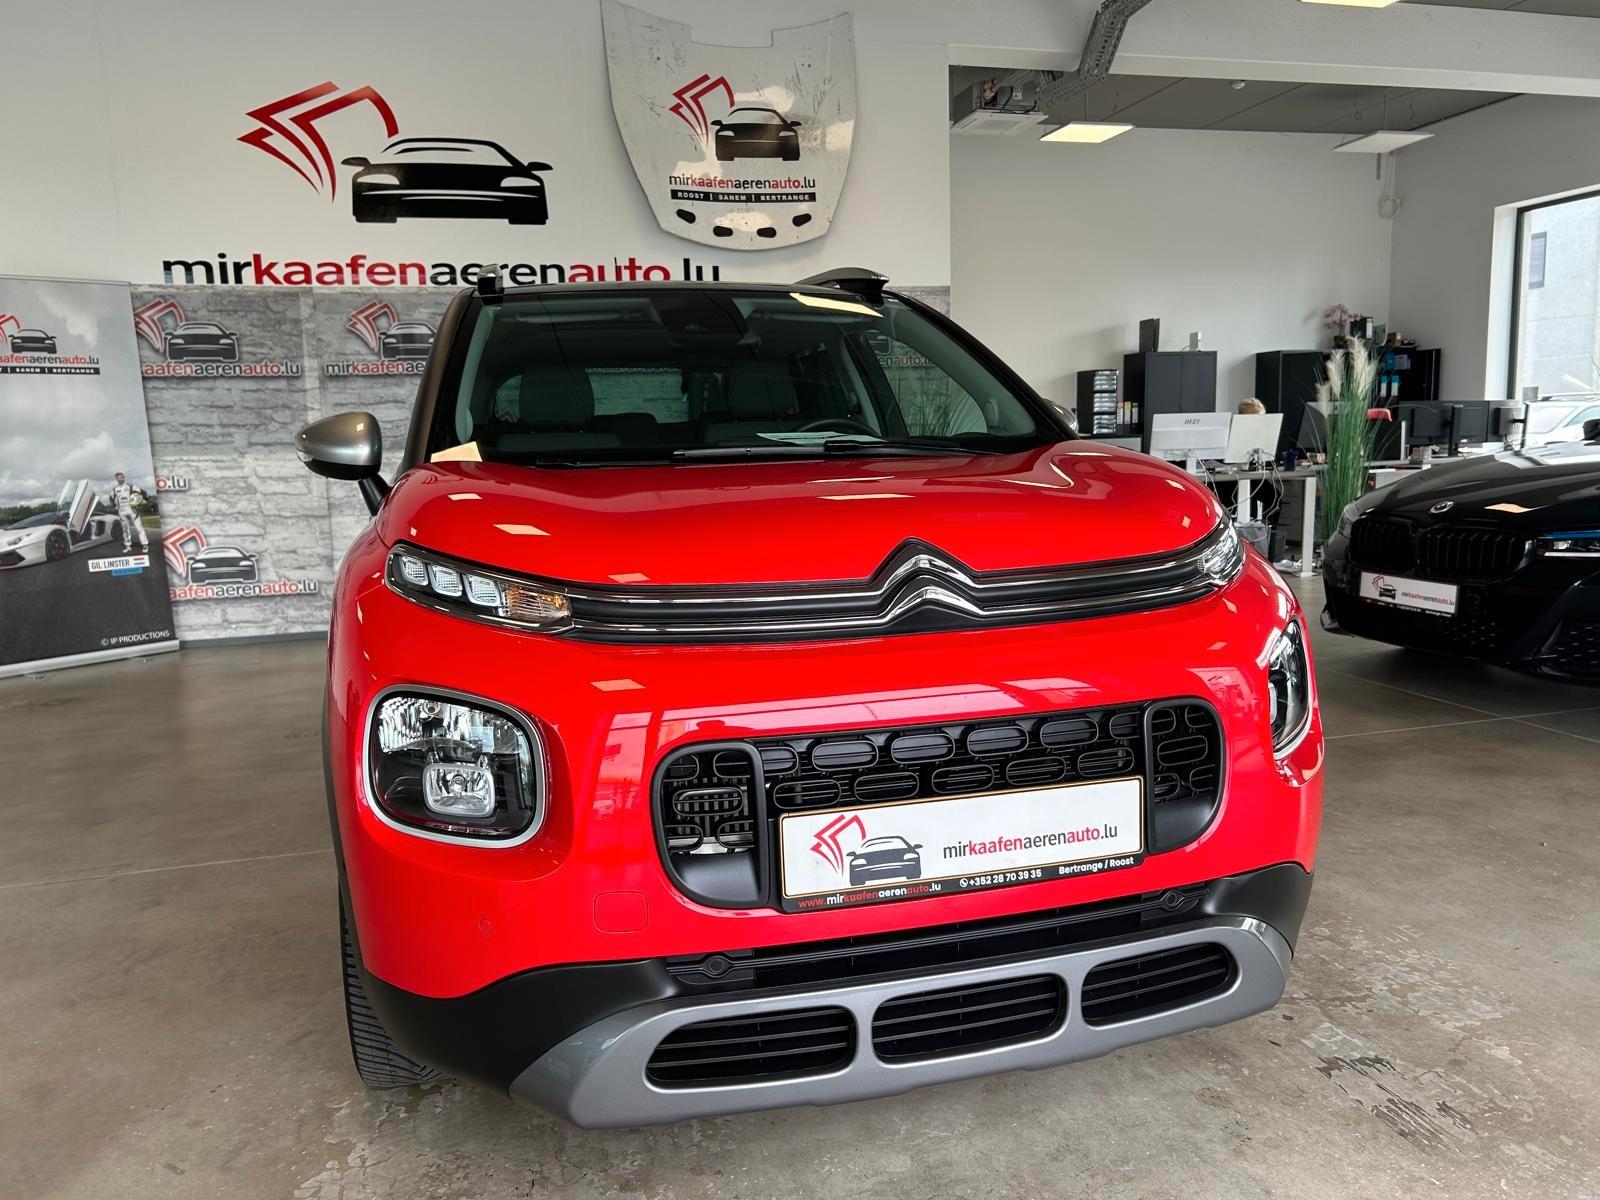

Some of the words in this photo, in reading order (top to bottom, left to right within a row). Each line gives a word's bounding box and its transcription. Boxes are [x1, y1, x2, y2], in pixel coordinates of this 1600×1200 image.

[669, 174, 816, 189] mirkaafenaerenauto.lu
[677, 192, 705, 200] ROOST
[91, 561, 102, 570] GIL
[104, 559, 130, 568] LINSTER
[110, 637, 119, 645] IP
[119, 630, 170, 643] PRODUCTIONS
[943, 824, 1118, 859] mirkaafenaerenauto.lu
[798, 883, 941, 908] www.mirkaafenaerenauto.lu
[969, 874, 991, 886] +352
[1005, 872, 1017, 882] 70
[1018, 871, 1029, 881] 39
[1030, 869, 1042, 879] 35
[1059, 861, 1103, 875] Bertrange
[1109, 856, 1135, 868] Roost
